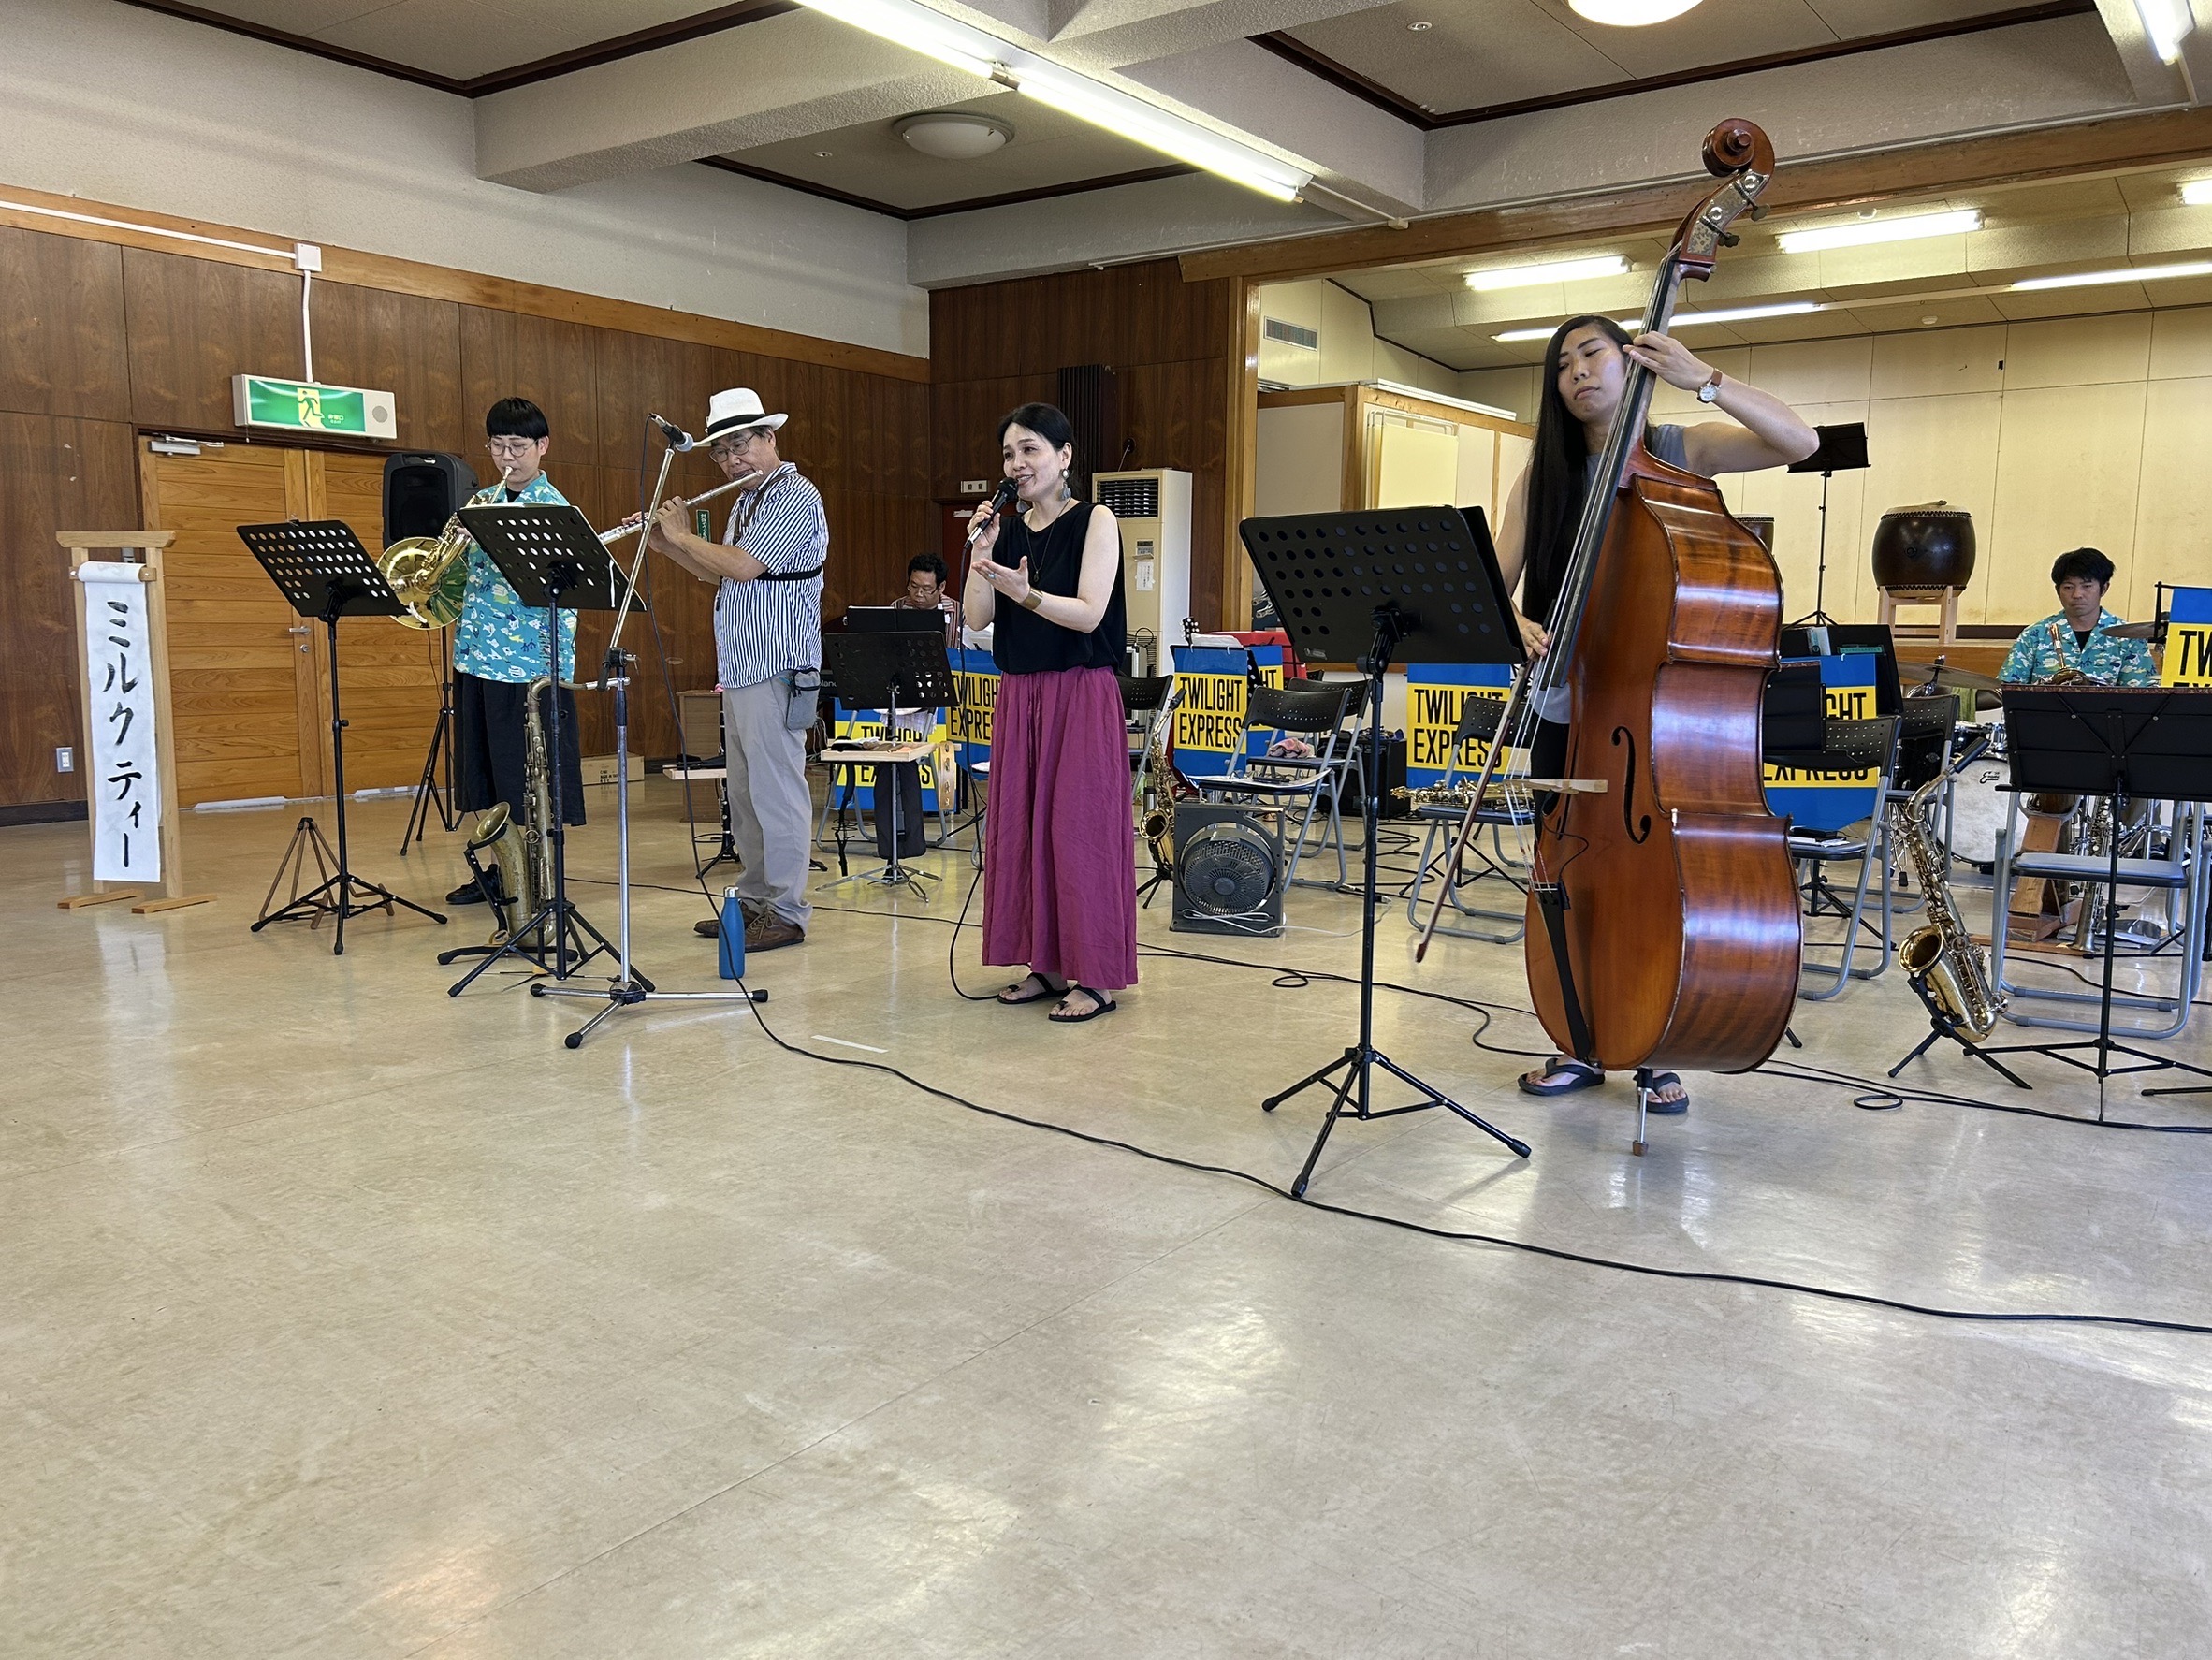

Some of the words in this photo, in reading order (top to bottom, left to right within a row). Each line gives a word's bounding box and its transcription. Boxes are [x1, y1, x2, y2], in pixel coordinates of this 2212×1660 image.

[1180, 677, 1242, 712] TWILIGHT
[102, 601, 143, 867] ミルクティー
[951, 707, 995, 740] EXPRE
